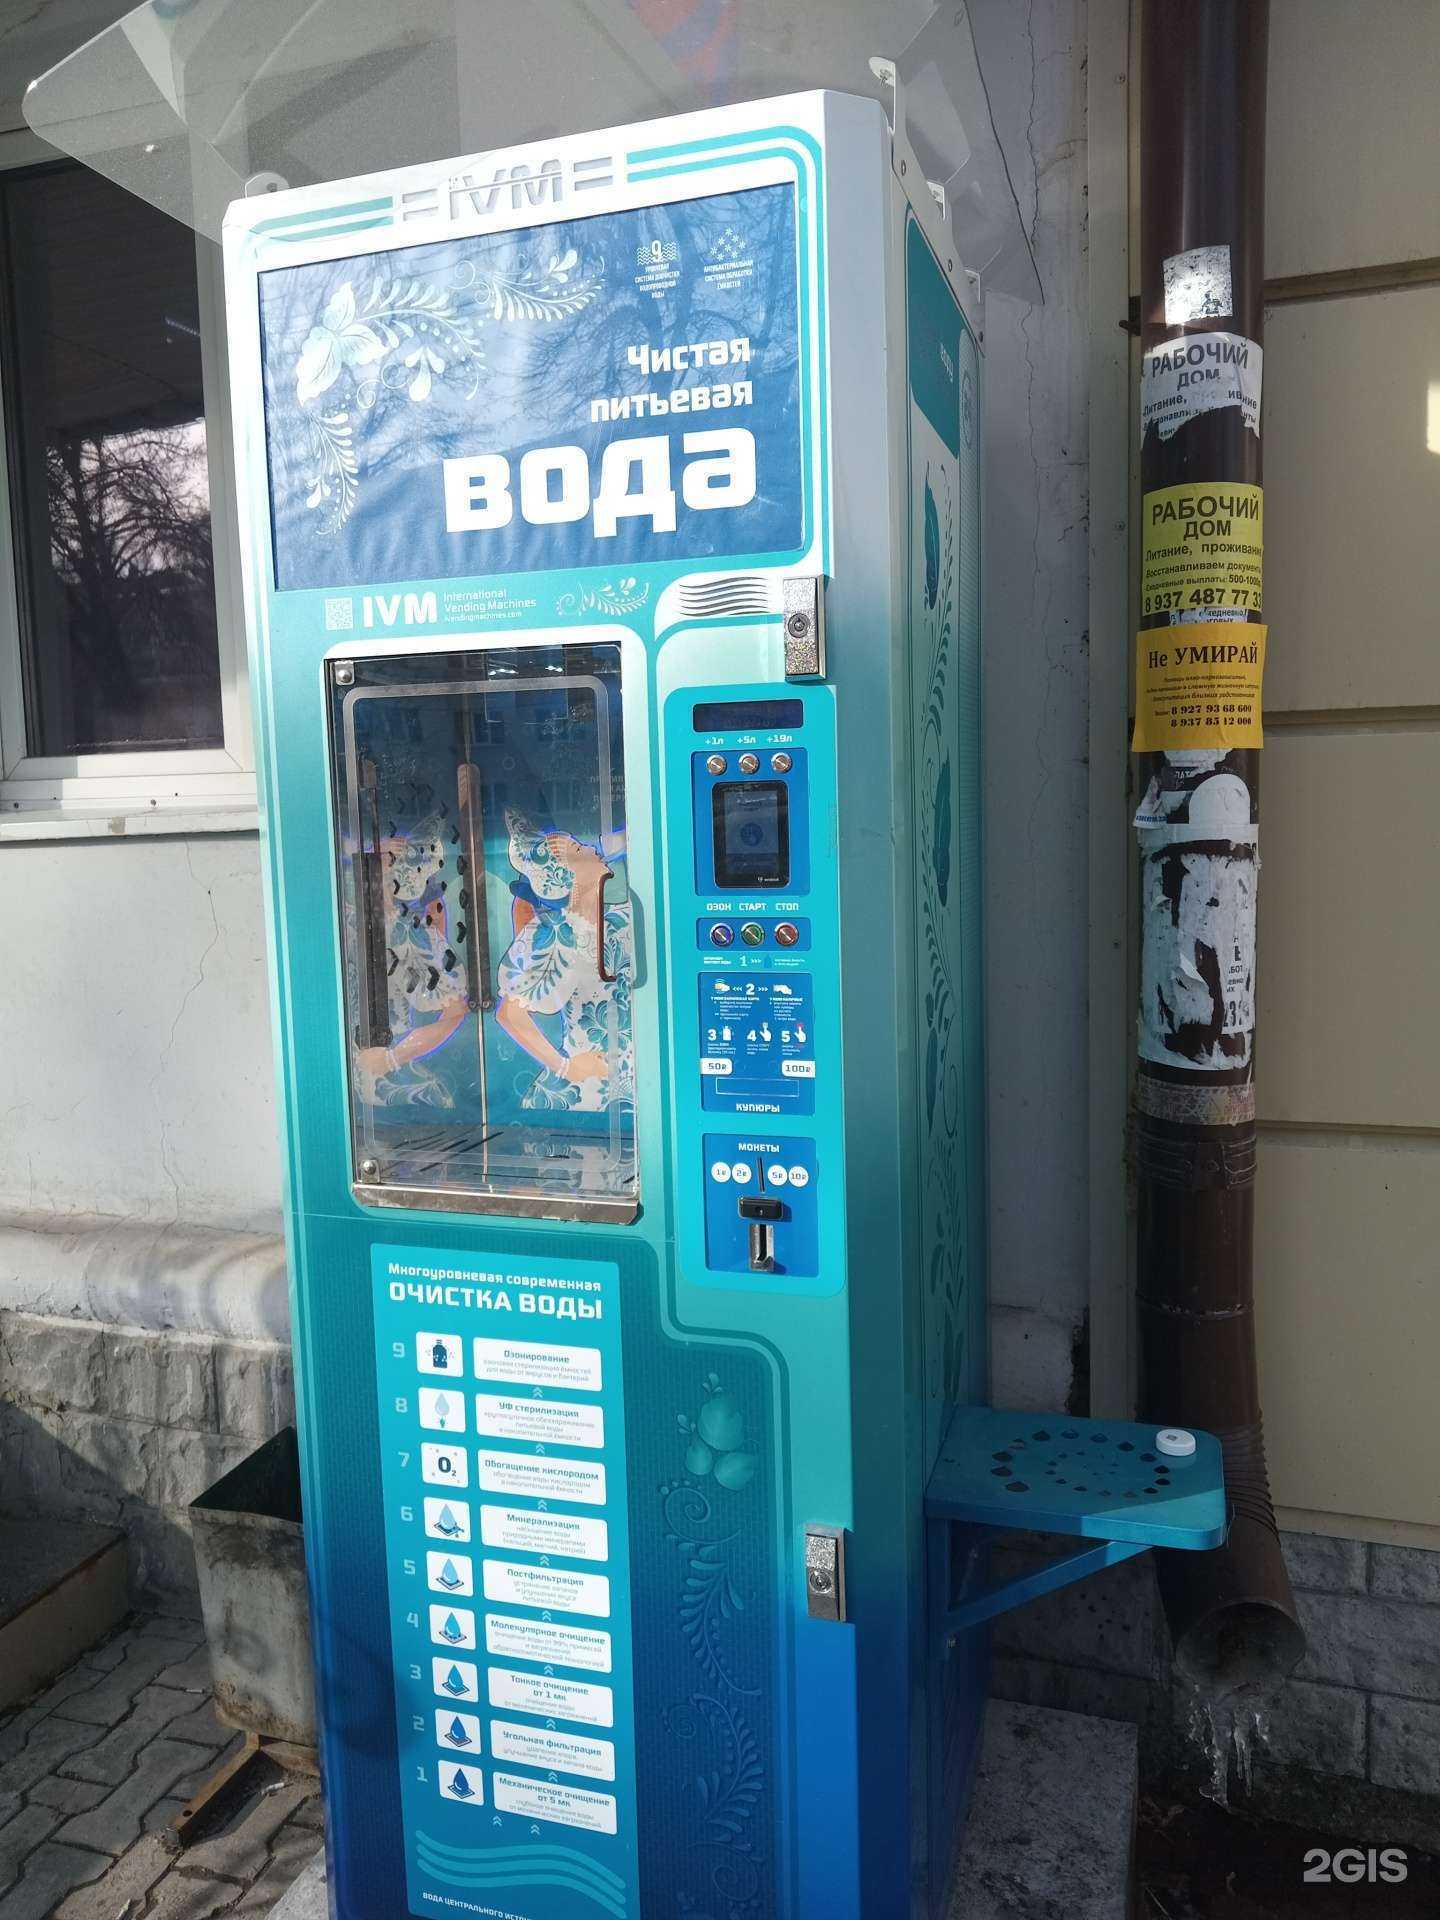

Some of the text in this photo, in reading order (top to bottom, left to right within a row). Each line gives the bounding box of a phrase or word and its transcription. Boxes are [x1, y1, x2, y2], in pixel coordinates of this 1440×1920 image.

[449, 159, 563, 220] IVM
[627, 337, 751, 374] Чистая
[1152, 342, 1249, 378] РАБОЧИЙ
[1176, 368, 1220, 392] ДОМ
[590, 379, 753, 423] питьевая
[442, 426, 758, 539] вода
[1152, 494, 1259, 526] РАБОЧИЙ
[1183, 519, 1231, 541] ДОМ
[1145, 543, 1262, 562] Питание, проживани
[443, 588, 507, 604] International
[1145, 596, 1152, 613] 8
[1154, 590, 1183, 611] 937
[1189, 588, 1226, 606] 487
[1231, 588, 1250, 606] 77
[363, 591, 438, 628] IVM
[445, 597, 537, 614] Vending Machines
[1148, 640, 1259, 669] Не УМИРАЙ
[1171, 705, 1178, 715] 8
[1180, 705, 1202, 715] 927
[1205, 704, 1220, 713] 93
[1222, 704, 1236, 713] 68
[1237, 704, 1252, 713] 600
[1170, 719, 1178, 728] 8
[1223, 717, 1235, 726] 12
[706, 902, 799, 911] ОЗОН СТАРТ СТОП
[739, 955, 748, 967] 1
[745, 983, 755, 995] 2
[707, 1028, 717, 1041] 3
[746, 1030, 757, 1042] 4
[781, 1030, 791, 1043] 5
[736, 1103, 781, 1113] КУПЮРЫ
[738, 1142, 780, 1153] МОНЕТЫ
[388, 1262, 601, 1292] Многоуровневая современная
[389, 1281, 603, 1321] ОЧИСТКА ВОДЫ
[392, 1342, 406, 1359] 9
[503, 1349, 571, 1365] Озонирование
[395, 1397, 408, 1413] 8
[498, 1401, 580, 1418] УФ стерилизация
[398, 1451, 410, 1467] 7
[484, 1458, 600, 1481] Обогащение кислородом
[400, 1506, 414, 1522] 6
[506, 1513, 581, 1530] Минерализация
[403, 1559, 416, 1576] 5
[507, 1568, 584, 1587] Постфильтрация
[406, 1611, 420, 1628] 4
[490, 1619, 606, 1645] Молекулярное очищение
[410, 1663, 422, 1681] 3
[511, 1674, 590, 1696] Тонкое очищение
[545, 1690, 551, 1699] 1
[412, 1714, 425, 1732] 2
[502, 1730, 602, 1757] Угольная фильтрация
[416, 1765, 428, 1783] 1
[499, 1777, 610, 1807] Механическое очищение
[537, 1795, 548, 1803] от
[422, 1892, 444, 1904] ВОДА
[444, 1896, 504, 1919] ЦЕНТРАЛЬНОГО
